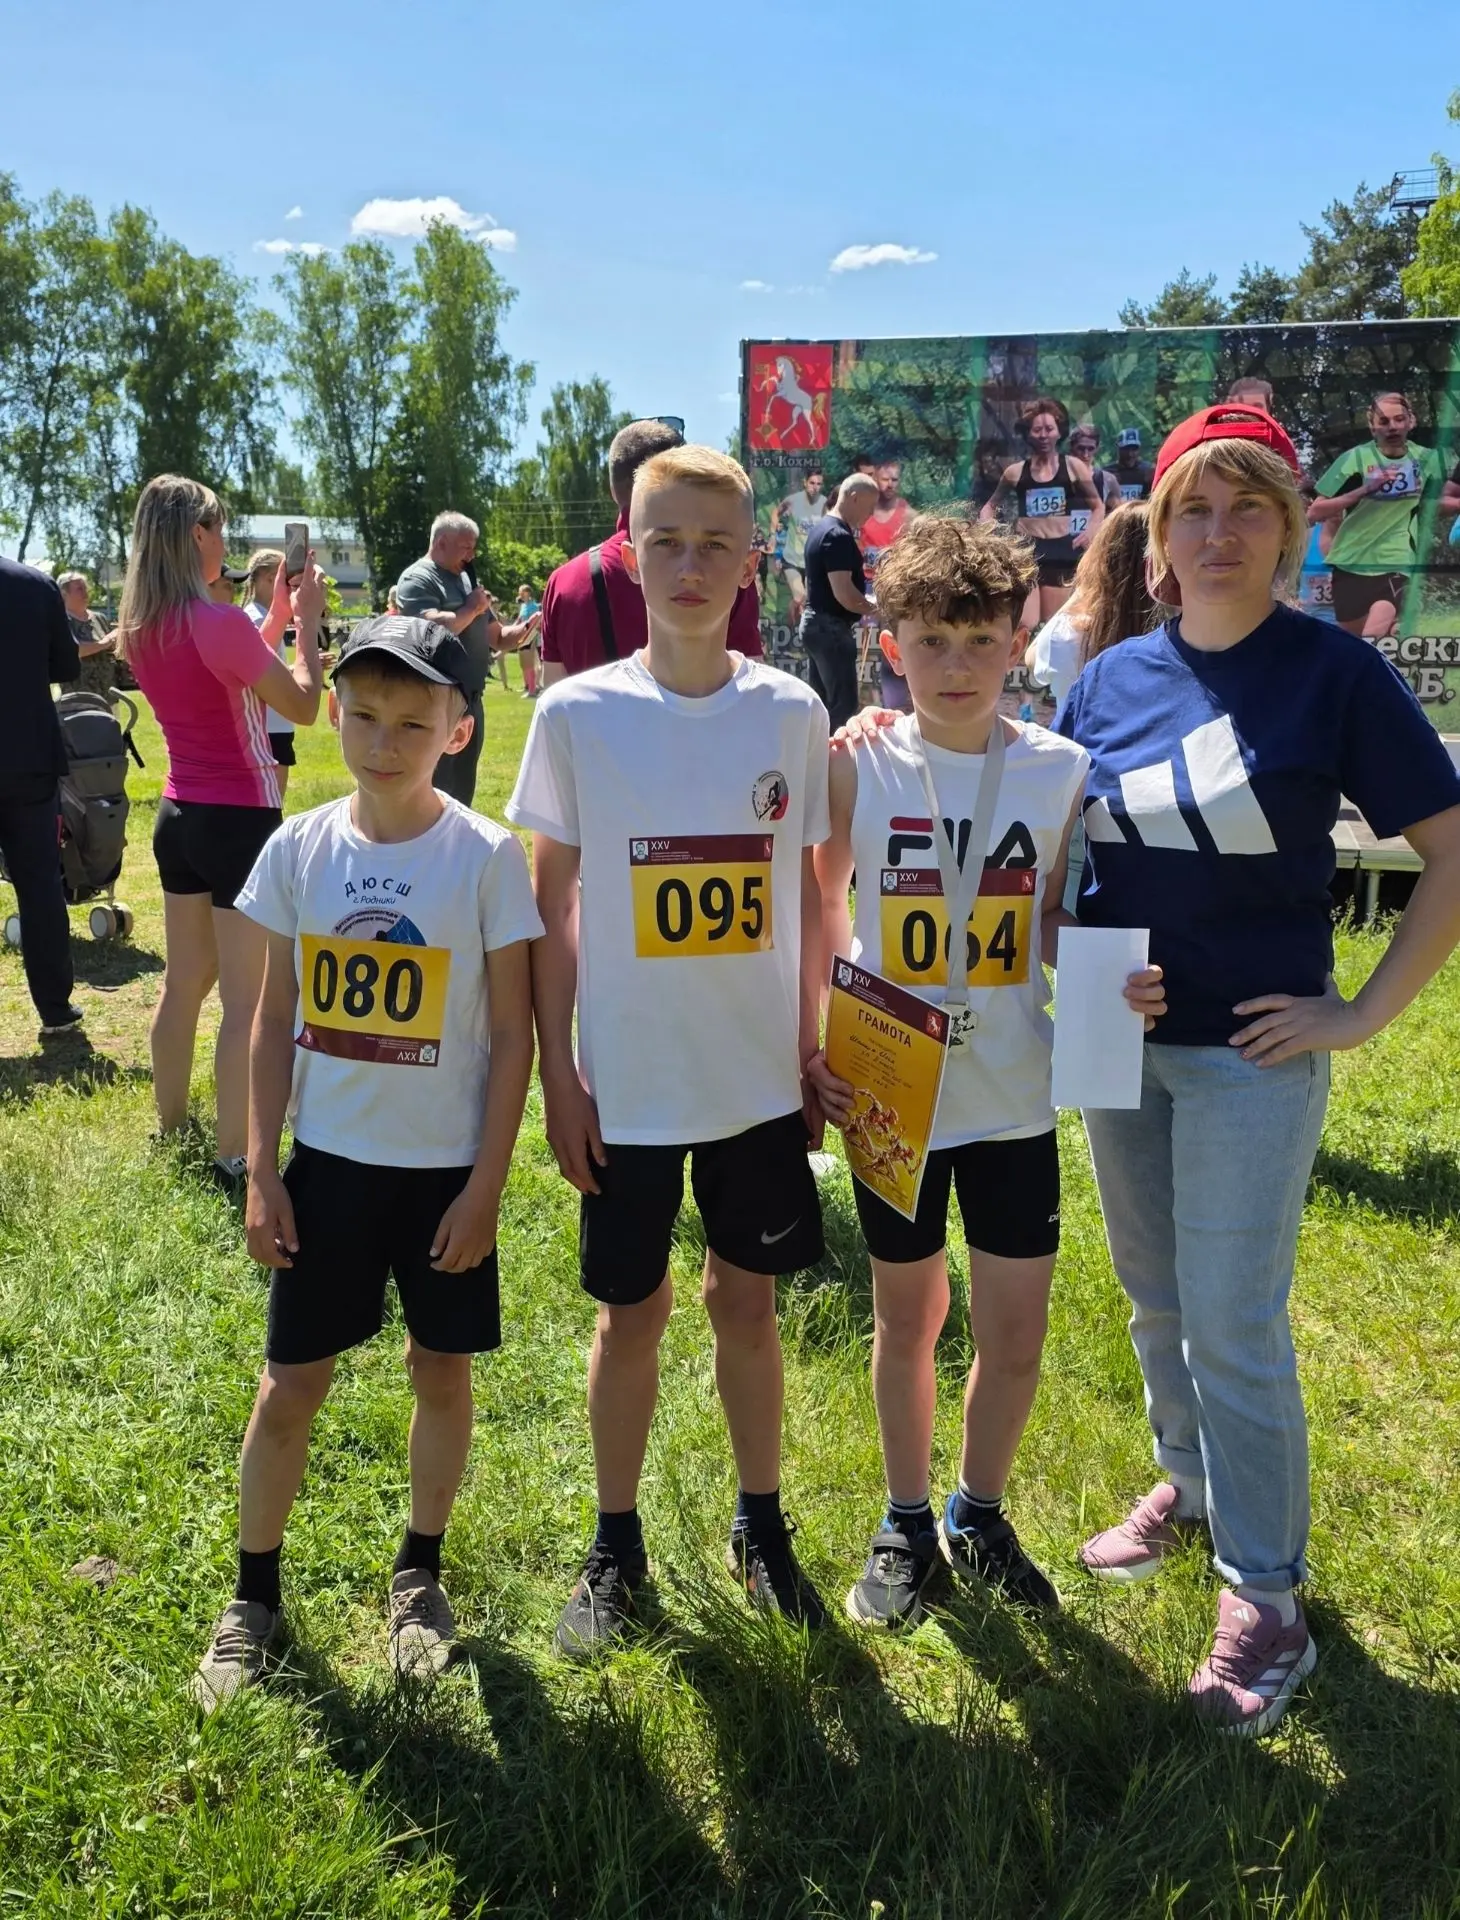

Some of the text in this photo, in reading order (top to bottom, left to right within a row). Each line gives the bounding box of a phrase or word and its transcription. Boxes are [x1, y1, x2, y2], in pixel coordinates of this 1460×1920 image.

[778, 455, 820, 467] Кохма
[1032, 496, 1059, 513] 135
[651, 840, 670, 850] XXV
[899, 872, 919, 882] XXV
[360, 895, 397, 905] Родники
[656, 876, 763, 943] 095
[313, 949, 423, 1023] 080
[854, 971, 871, 987] XXV
[858, 1008, 912, 1048] ГРАМОТА
